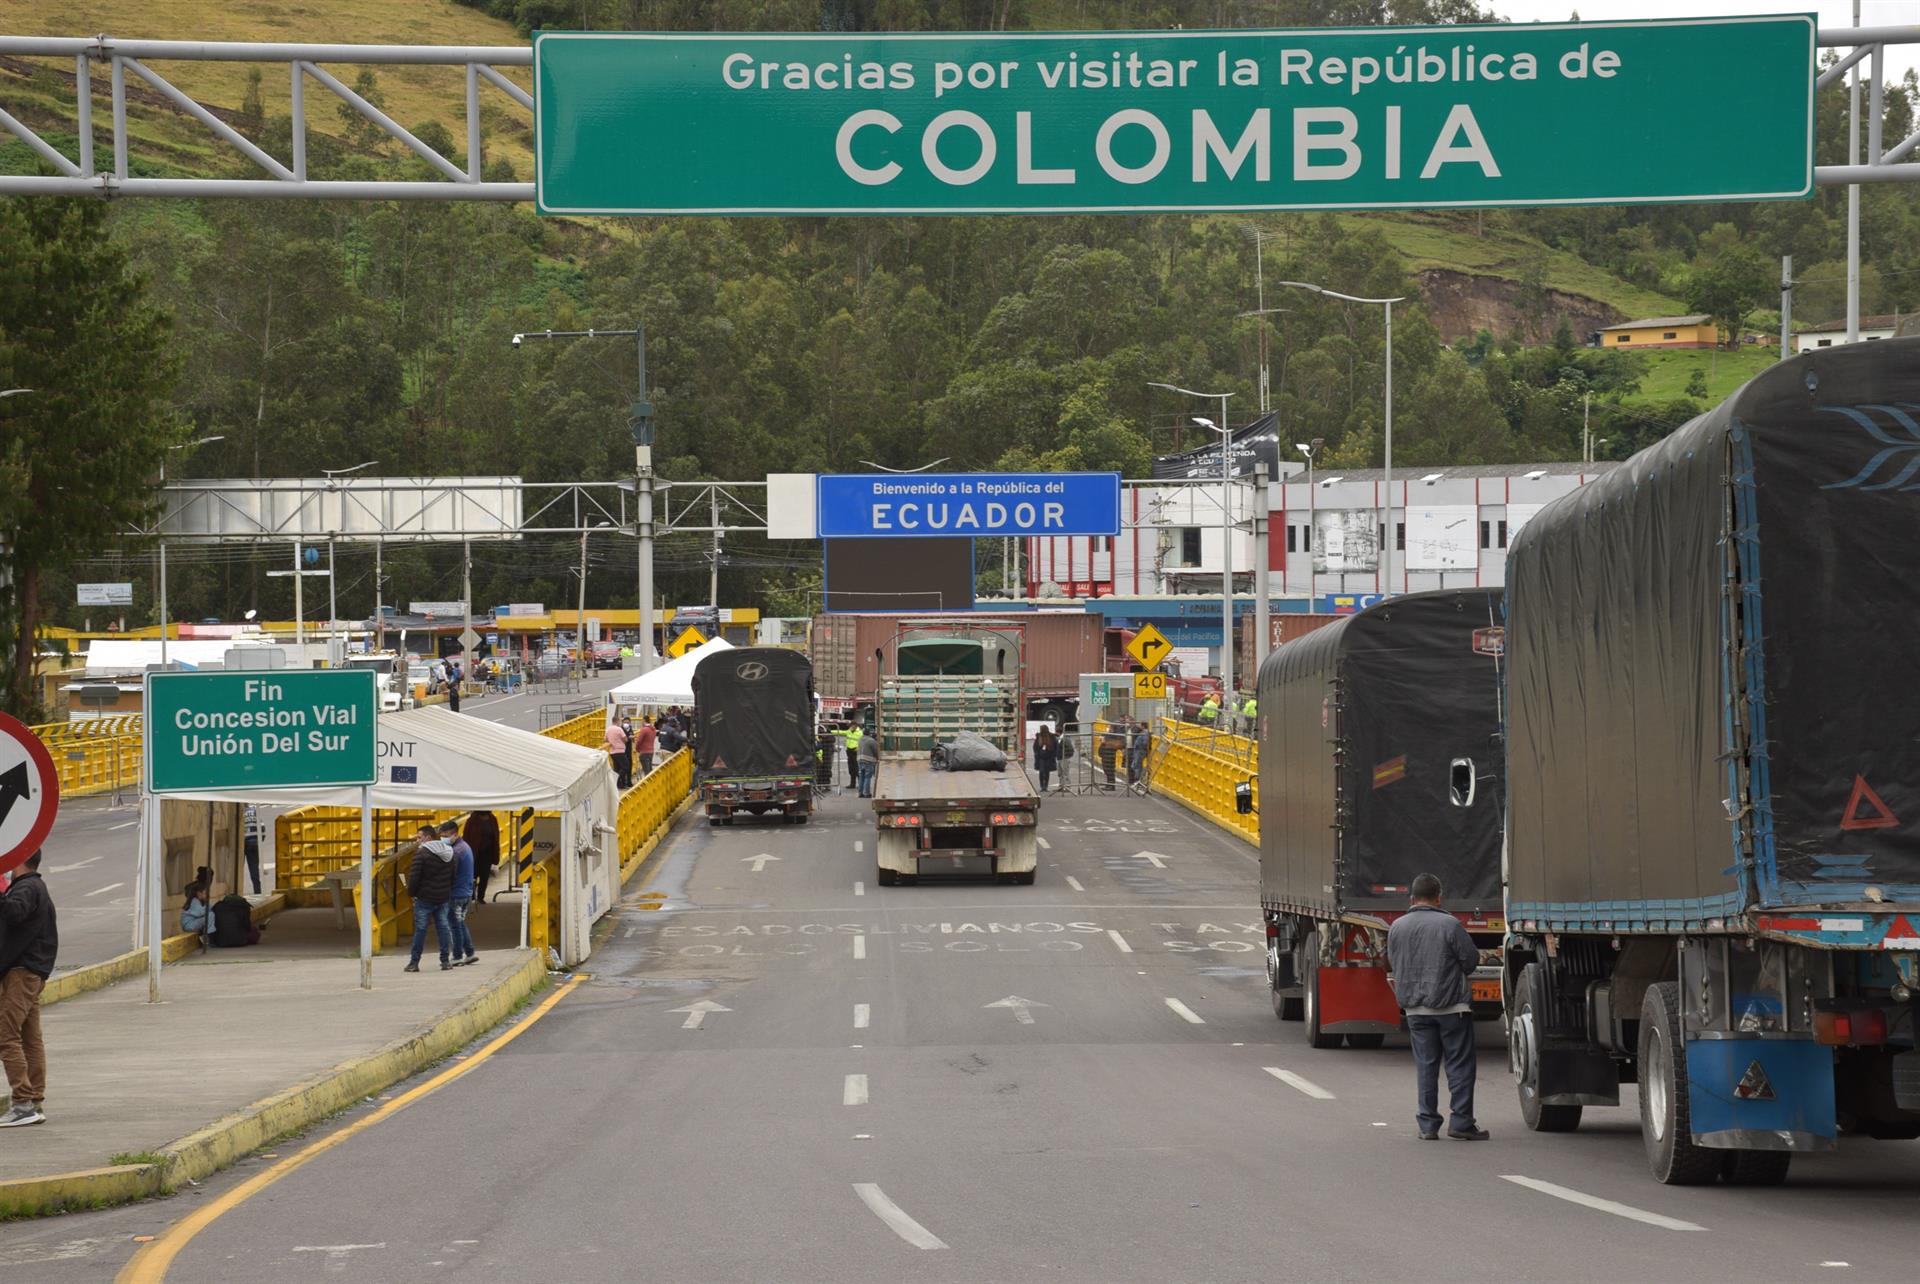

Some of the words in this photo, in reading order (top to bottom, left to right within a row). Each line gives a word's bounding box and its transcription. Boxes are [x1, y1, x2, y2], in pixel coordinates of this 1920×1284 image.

[723, 53, 914, 90] Gracias
[936, 62, 1018, 98] por
[1038, 52, 1197, 88] visitar
[1219, 51, 1258, 86] la
[1281, 45, 1536, 95] República
[1560, 43, 1620, 79] de
[836, 105, 1502, 186] COLOMBIA
[873, 482, 946, 495] Bienvenido
[949, 484, 957, 494] a
[961, 482, 973, 494] la
[977, 481, 1041, 496] República
[1044, 481, 1064, 493] del
[872, 503, 1065, 529] ECUADOR
[246, 681, 282, 701] Fin
[1138, 675, 1163, 689] 40
[175, 707, 305, 730] Concesion
[312, 705, 356, 725] Vial
[182, 732, 254, 756] Unión
[262, 732, 300, 754] Del
[308, 730, 350, 752] Sur
[623, 923, 865, 938] PESADOS
